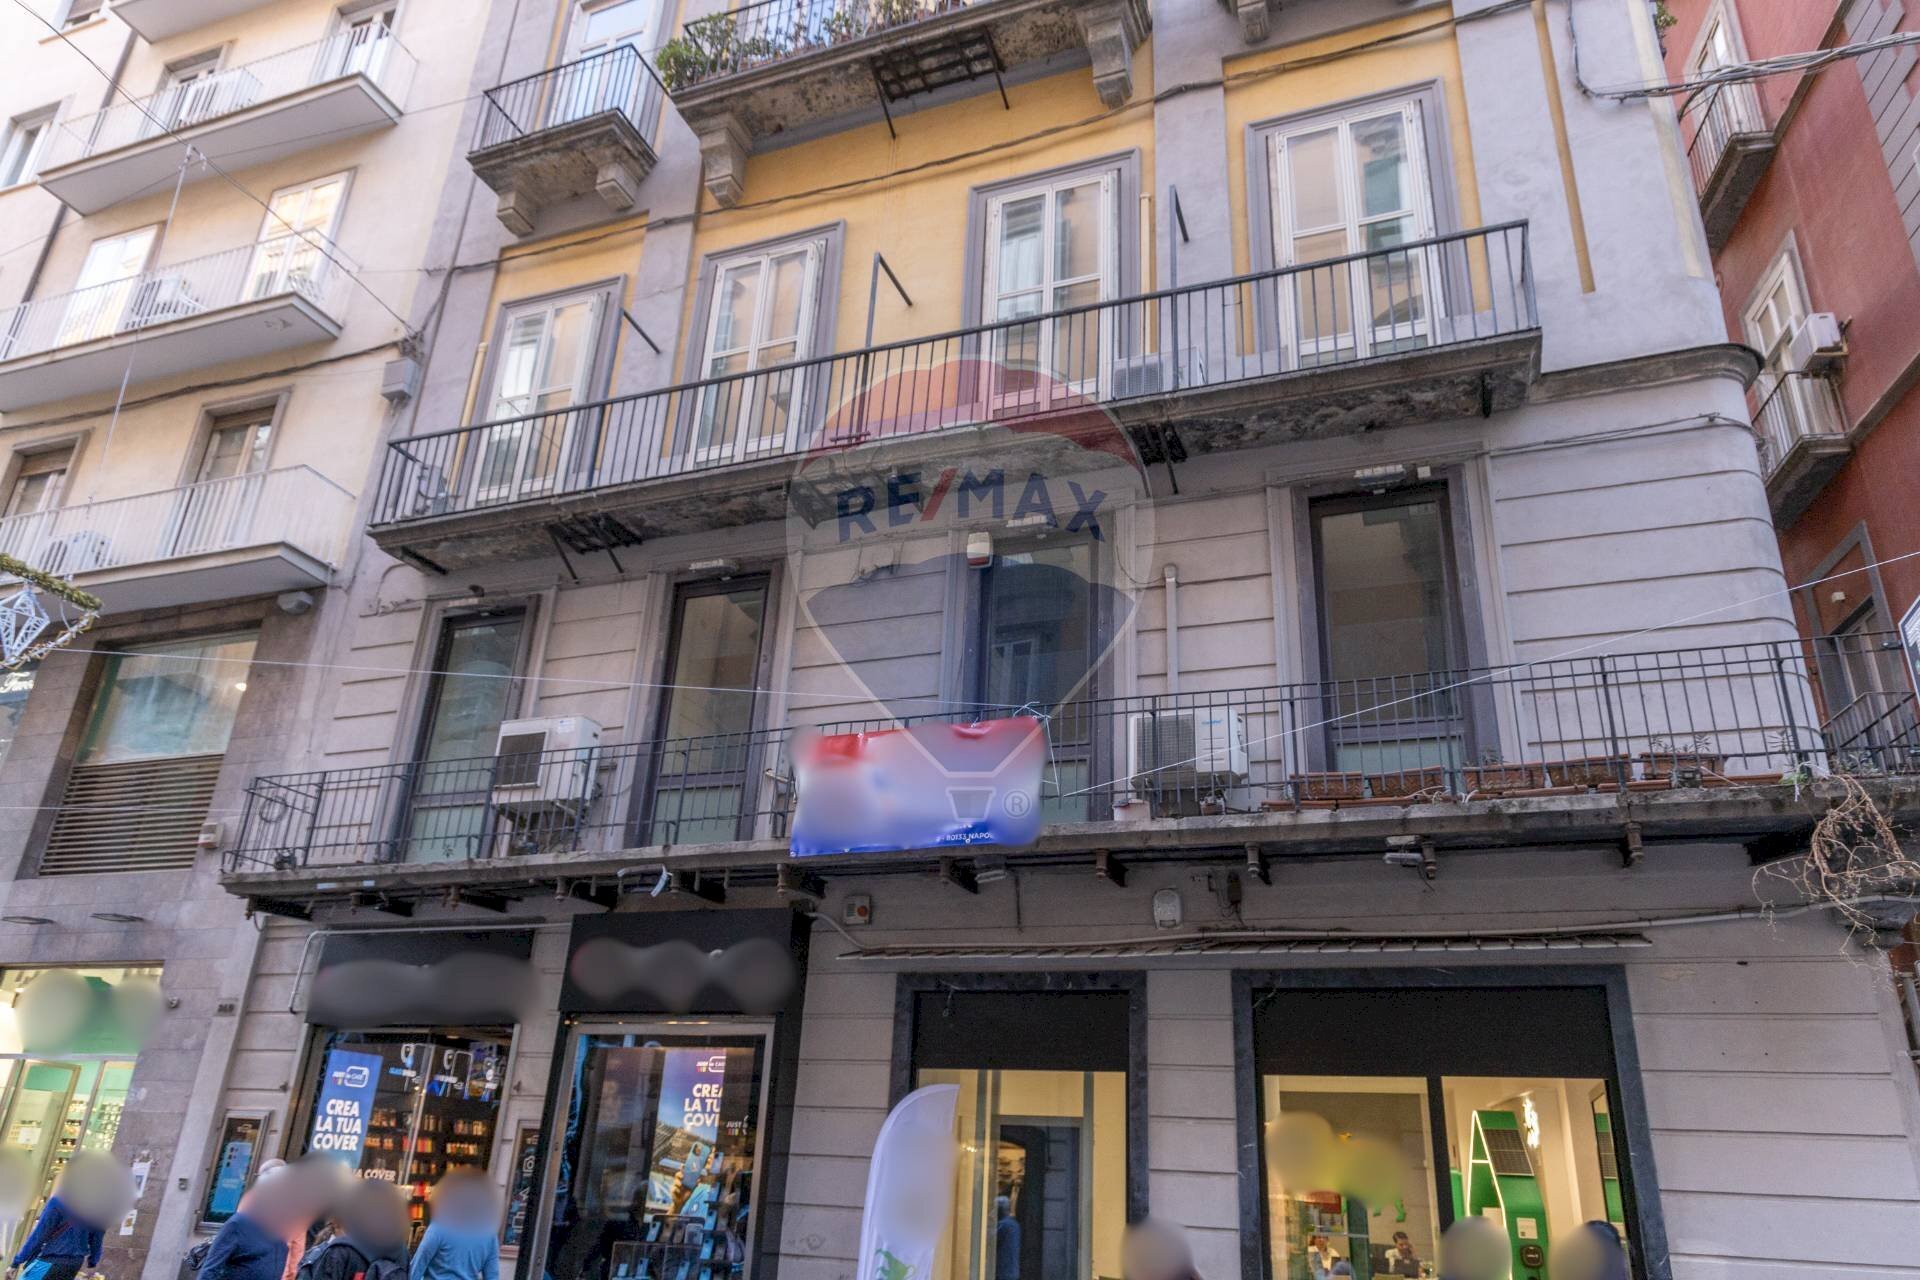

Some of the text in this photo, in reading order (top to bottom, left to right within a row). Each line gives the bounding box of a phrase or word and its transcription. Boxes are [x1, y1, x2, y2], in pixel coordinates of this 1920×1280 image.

[326, 1098, 360, 1117] CREA
[684, 1098, 702, 1112] LA
[315, 1115, 362, 1134] LA TUA
[313, 1133, 359, 1151] COVER
[363, 1168, 396, 1181] COVER
